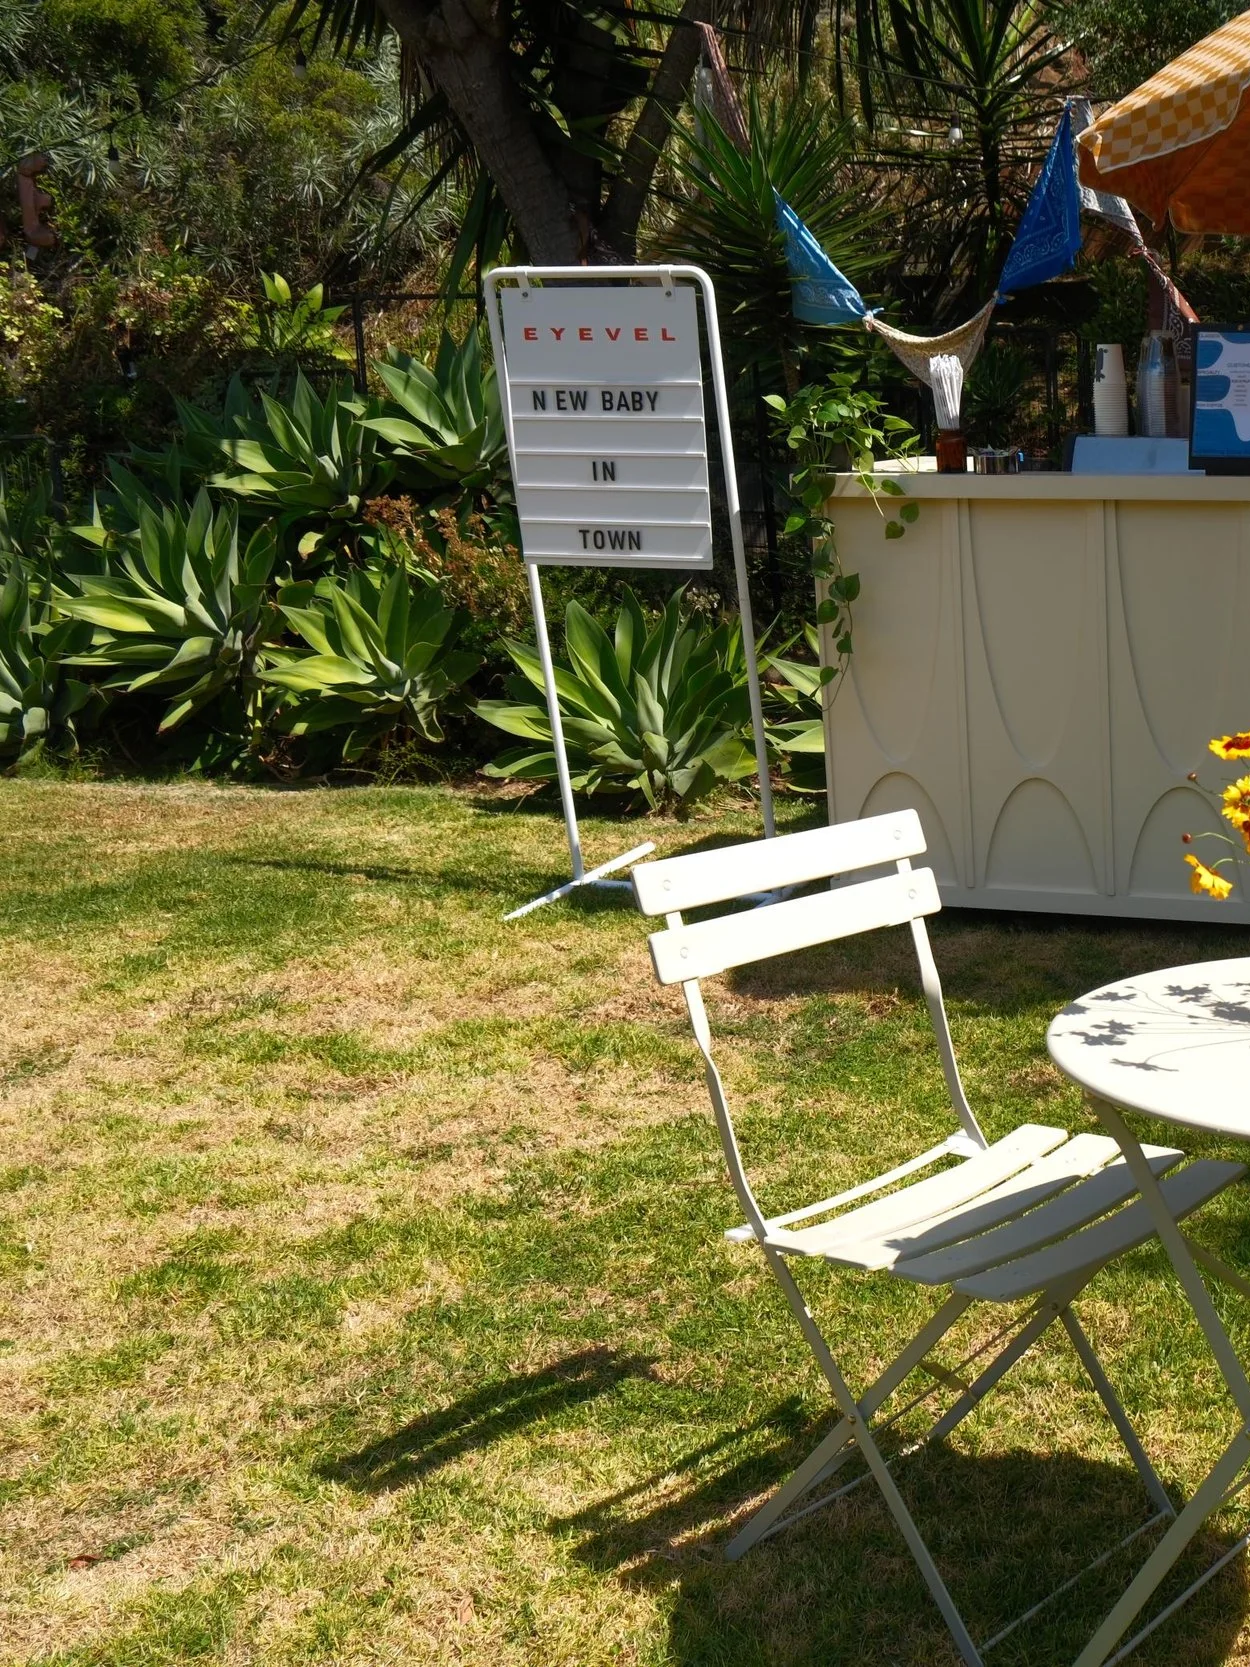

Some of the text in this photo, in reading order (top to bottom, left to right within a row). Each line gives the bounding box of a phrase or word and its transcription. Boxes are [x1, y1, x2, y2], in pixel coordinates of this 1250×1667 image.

[523, 327, 676, 341] EYEVEL
[532, 390, 659, 412] NEW BABY
[591, 460, 616, 482] IN
[578, 529, 641, 551] TOWN
